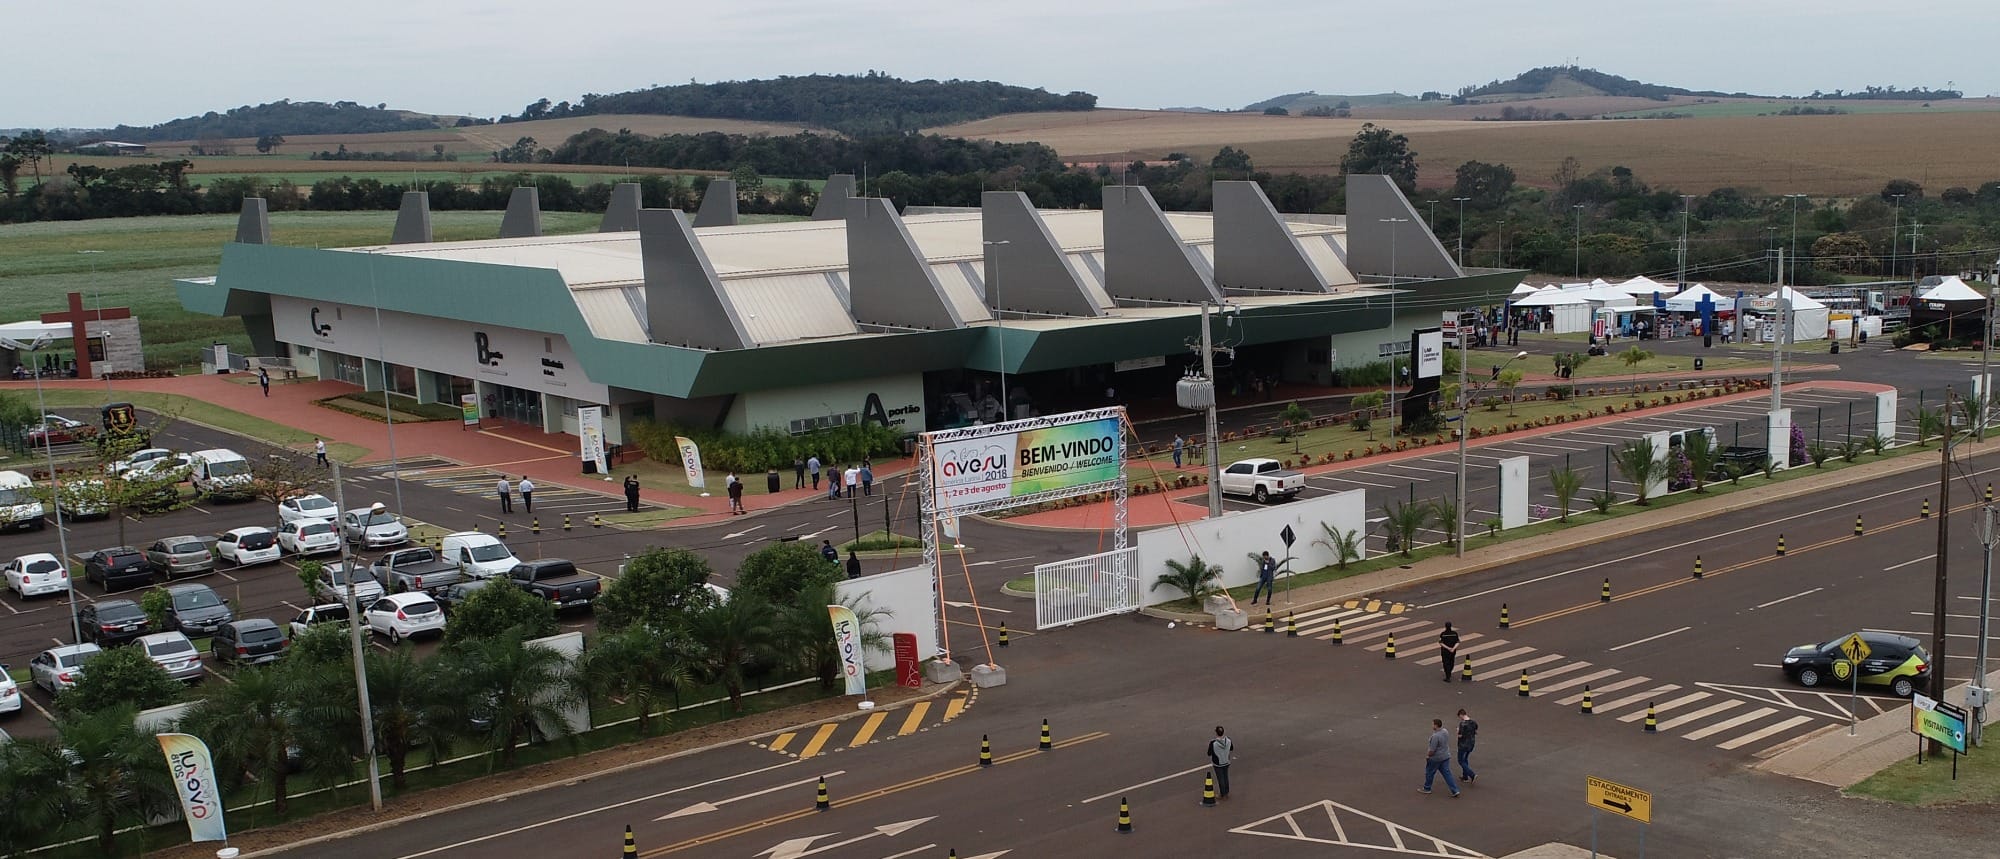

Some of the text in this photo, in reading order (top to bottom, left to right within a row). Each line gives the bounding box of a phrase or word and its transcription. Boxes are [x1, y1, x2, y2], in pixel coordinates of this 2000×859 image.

[474, 331, 490, 365] B
[861, 392, 920, 428] A portão
[889, 417, 906, 427] gate
[1020, 436, 1113, 467] BEM-VINDO
[985, 468, 1008, 481] 2018
[1021, 462, 1068, 478] BIENVENIDO
[1076, 455, 1113, 468] WELCOME
[952, 488, 958, 497] 2
[963, 487, 969, 495] 3
[970, 485, 980, 494] de
[981, 482, 1006, 494] agosto
[1923, 717, 1954, 737] VISITANTES
[1588, 779, 1648, 802] ESTACIONAMENTO
